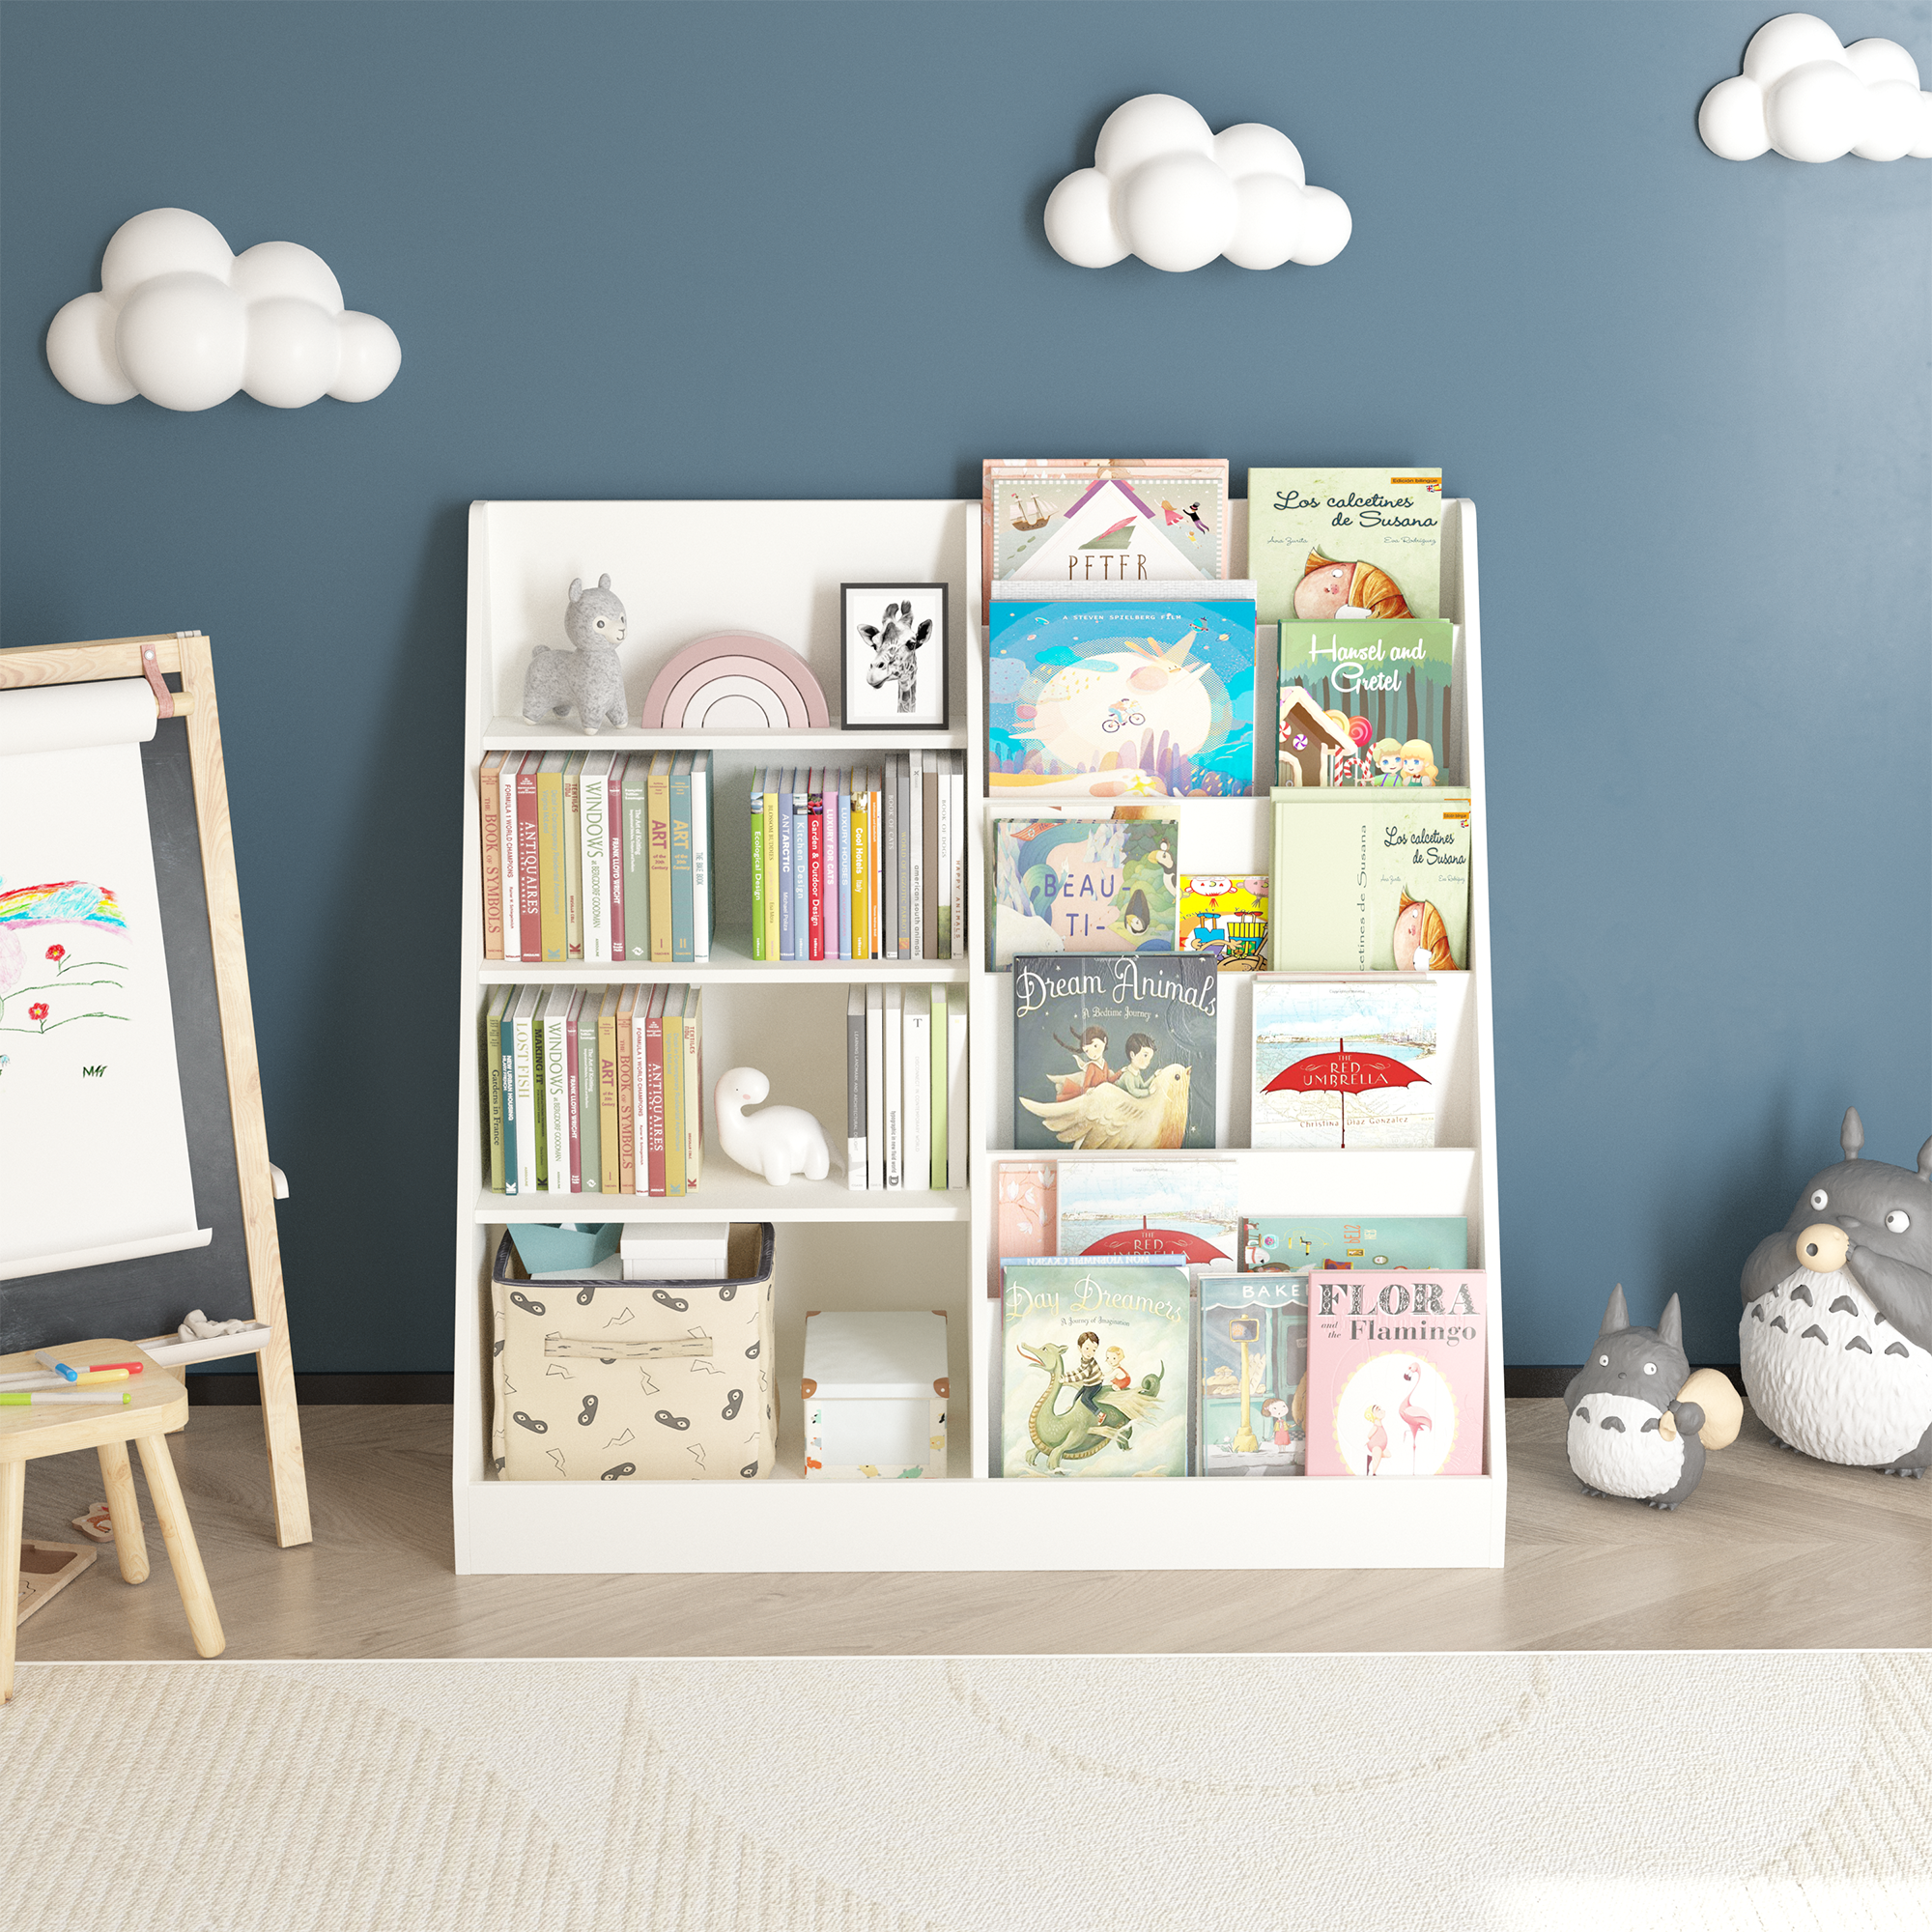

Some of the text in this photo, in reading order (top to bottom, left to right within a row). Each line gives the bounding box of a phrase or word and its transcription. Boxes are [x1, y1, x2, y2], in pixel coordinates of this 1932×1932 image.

[1273, 491, 1414, 510] Los calcetines
[1331, 511, 1437, 527] de Susana
[1068, 554, 1147, 580] PETER
[1309, 634, 1426, 662] Hansel and
[1331, 662, 1402, 695] Gretel
[485, 814, 498, 852] BOOK
[585, 781, 604, 858] WINDOWS
[888, 819, 895, 829] OF
[941, 824, 947, 834] OF
[652, 820, 667, 849] ART
[673, 820, 689, 849] ART
[1384, 826, 1455, 847] Los calcetines
[487, 855, 494, 864] OF
[525, 821, 538, 914] ANTIQUAIRES
[901, 860, 907, 870] OF
[1357, 825, 1367, 889] Susana
[1413, 847, 1466, 865] de Susana
[591, 866, 600, 895] BERGDORF
[753, 873, 762, 900] Design
[796, 866, 805, 898] Design
[854, 880, 863, 893] Italy
[1044, 874, 1130, 898] BEAU-
[487, 867, 500, 933] SYMBOLS
[592, 897, 601, 927] GOODMAN
[1357, 894, 1366, 912] de
[1065, 914, 1105, 937] TI-
[1016, 955, 1216, 1018] Dream Animals
[913, 1018, 923, 1028] T
[1082, 1006, 1151, 1022] A Bedtime Journey
[517, 1023, 529, 1097] LOST FISH
[534, 1029, 543, 1085] MAKING IT
[549, 1022, 563, 1094] WINDOWS
[1330, 1063, 1361, 1073] RED
[492, 1069, 500, 1104] Gardens
[602, 1059, 613, 1087] ART
[620, 1056, 631, 1092] BOOK
[1304, 1073, 1388, 1087] UMBRELLA
[493, 1106, 499, 1115] in
[621, 1094, 627, 1104] OF
[652, 1064, 663, 1151] ANTIQUAIRES
[553, 1102, 561, 1130] BERGDORF
[621, 1106, 633, 1169] SYMBOLS
[1134, 1239, 1163, 1250] RED
[1006, 1274, 1181, 1322] Day Dreamers
[1242, 1284, 1308, 1298] BAKE
[1317, 1283, 1481, 1317] FLORA
[1061, 1318, 1066, 1326] A
[1068, 1317, 1089, 1326] Journey
[1098, 1316, 1130, 1326] Imagination
[1350, 1320, 1476, 1347] Flamingo
